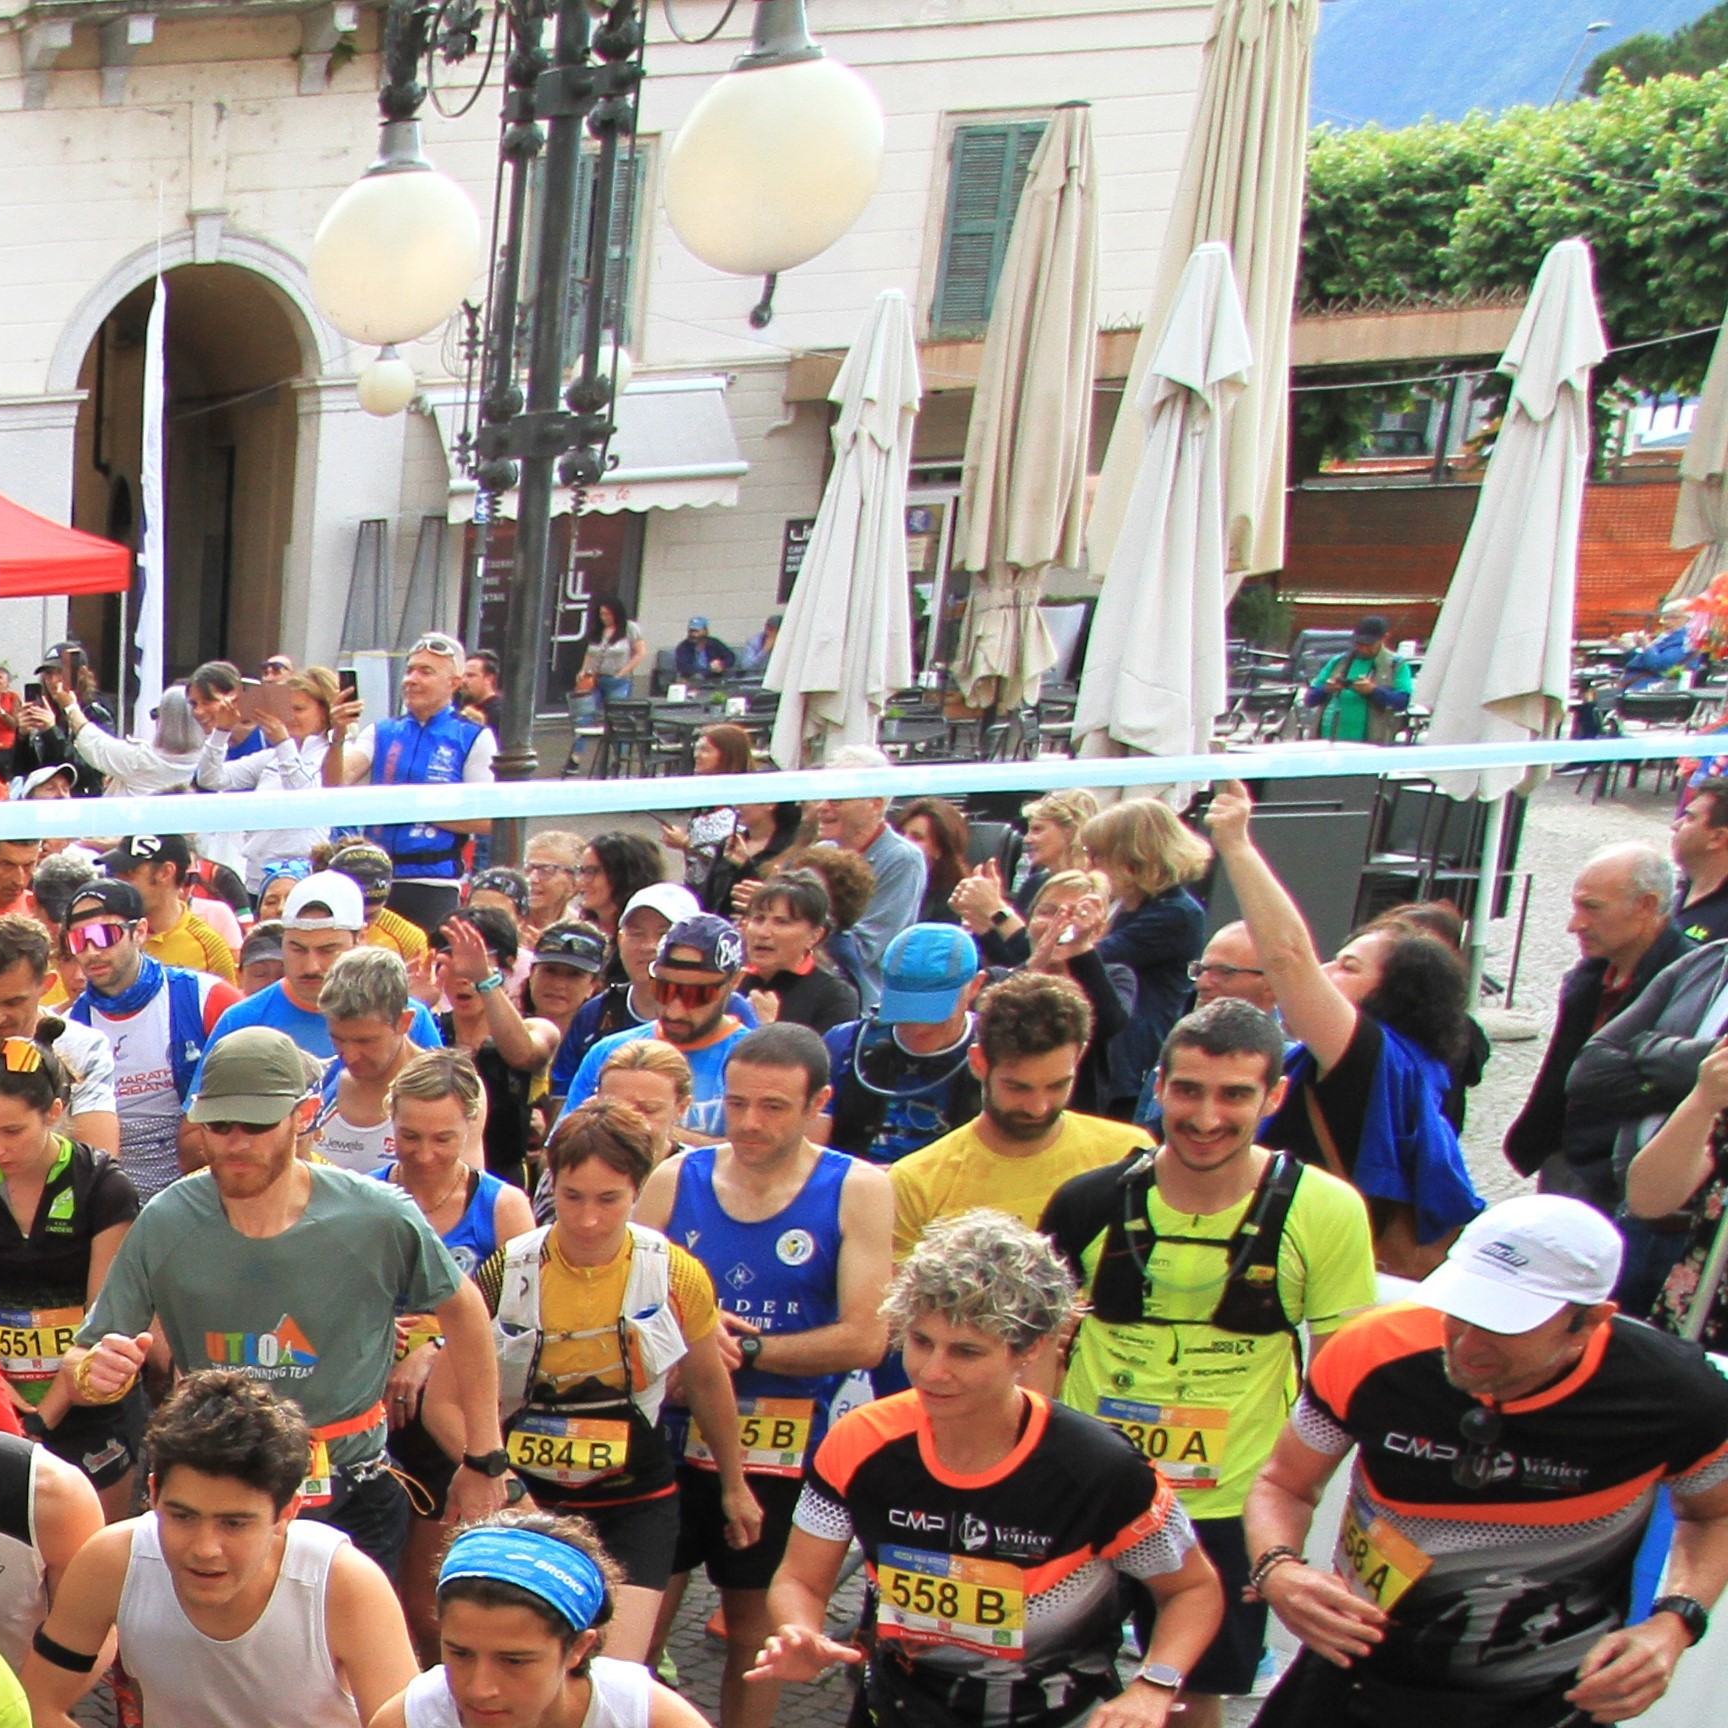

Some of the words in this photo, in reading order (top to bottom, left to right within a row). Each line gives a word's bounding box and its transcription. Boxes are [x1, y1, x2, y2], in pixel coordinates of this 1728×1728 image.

[0, 1330, 42, 1357] 551
[53, 1327, 75, 1355] B
[205, 1331, 279, 1367] UTLO
[288, 1365, 315, 1378] TEAM
[770, 1419, 795, 1449] B
[1178, 1430, 1207, 1463] A
[1383, 1432, 1458, 1461] CMP
[516, 1437, 575, 1469] 584
[588, 1442, 613, 1471] B
[888, 1508, 945, 1532] CMP
[994, 1525, 1053, 1545] Venice
[533, 1558, 586, 1597] BROOKS
[1366, 1562, 1392, 1595] A
[891, 1572, 959, 1619] 558
[975, 1587, 1007, 1626] B
